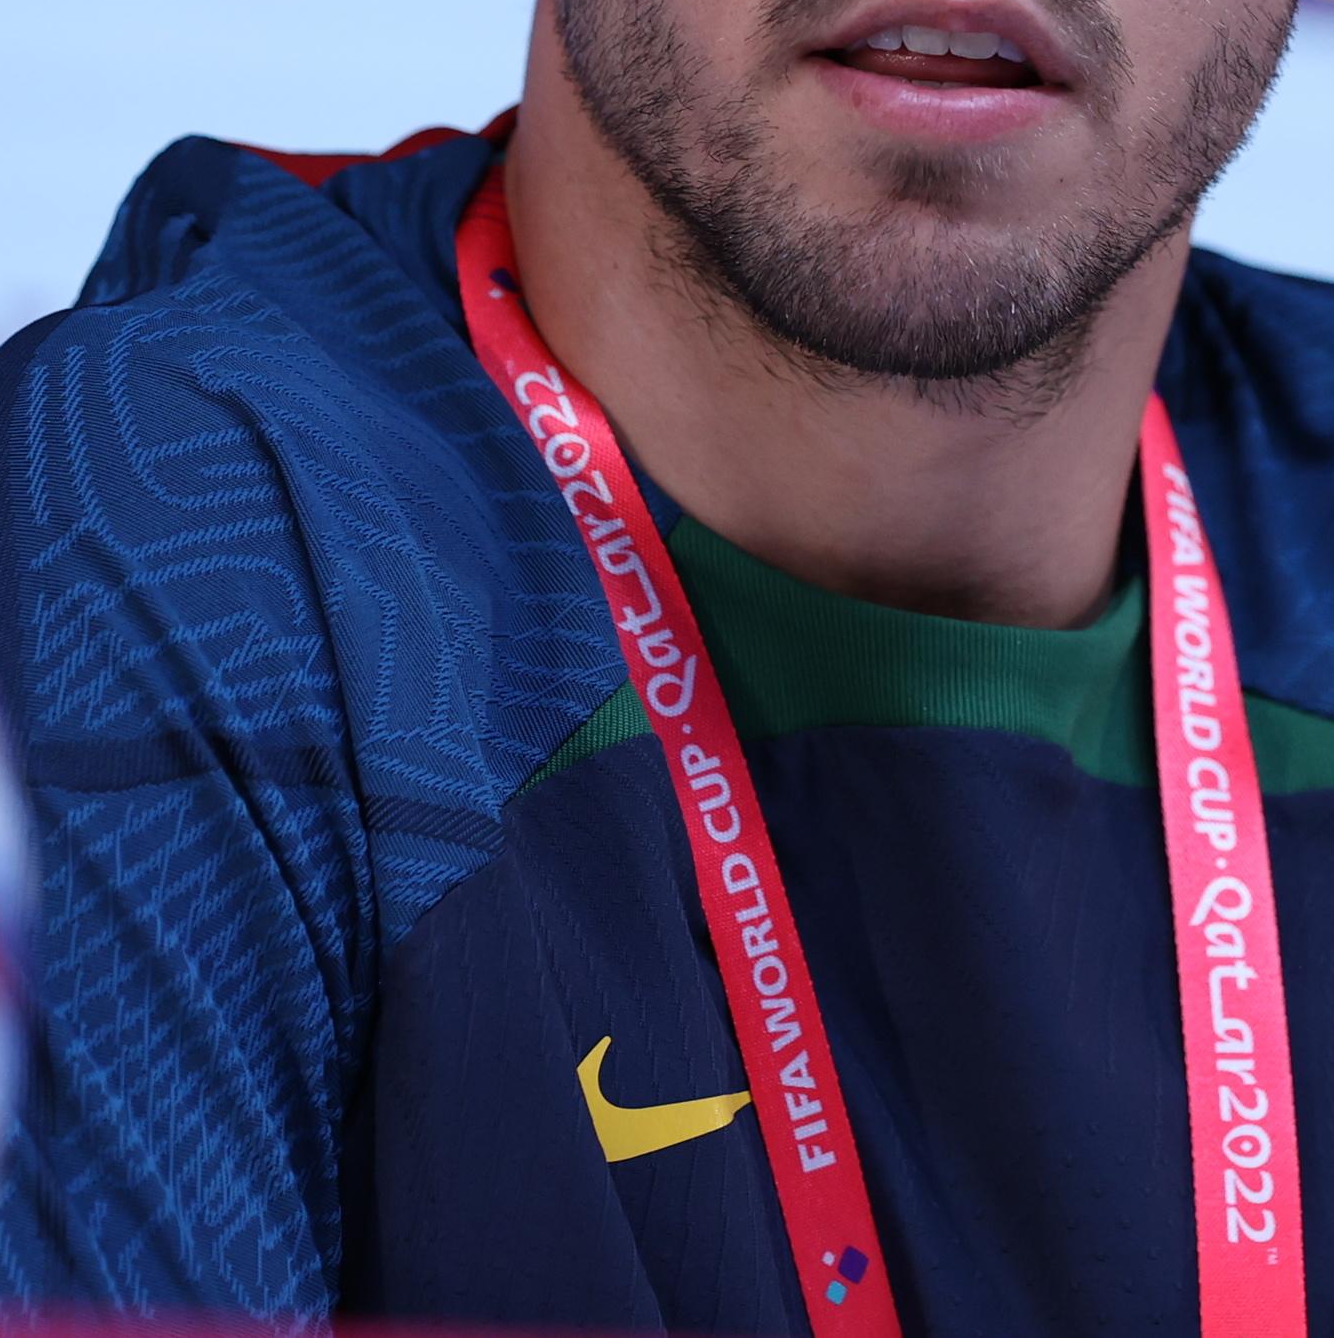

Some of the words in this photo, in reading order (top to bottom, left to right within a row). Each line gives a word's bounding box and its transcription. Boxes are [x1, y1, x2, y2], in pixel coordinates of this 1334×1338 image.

[1162, 463, 1207, 567] FIFA
[1172, 574, 1223, 752] WORLD
[680, 743, 741, 844] CUP
[1185, 756, 1239, 853] CUP
[721, 852, 802, 1052] WORLD
[779, 1050, 836, 1173] FIFA
